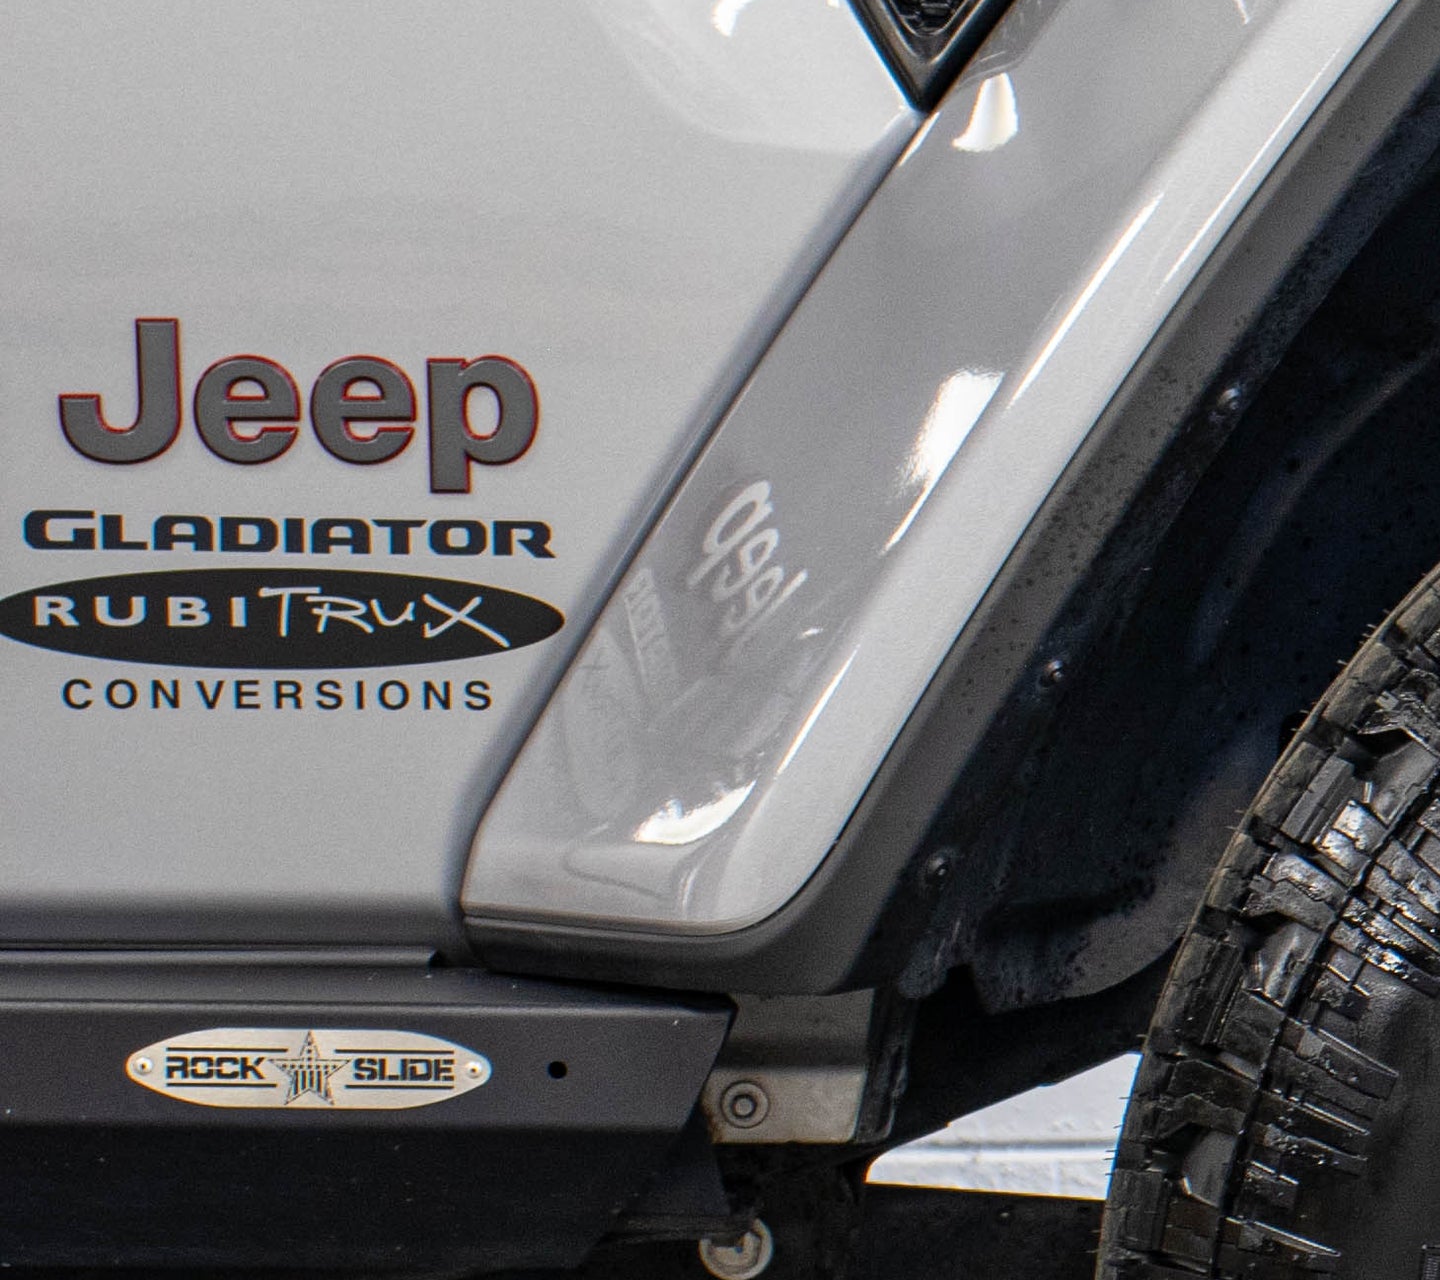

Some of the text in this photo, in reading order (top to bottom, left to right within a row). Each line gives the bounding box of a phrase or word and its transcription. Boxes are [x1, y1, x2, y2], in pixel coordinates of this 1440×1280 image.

[58, 317, 540, 493] Jeep
[22, 508, 557, 559] GLADIATOR
[62, 677, 495, 712] CONVERSIONS
[165, 1055, 455, 1082] ROCK SLIDE
